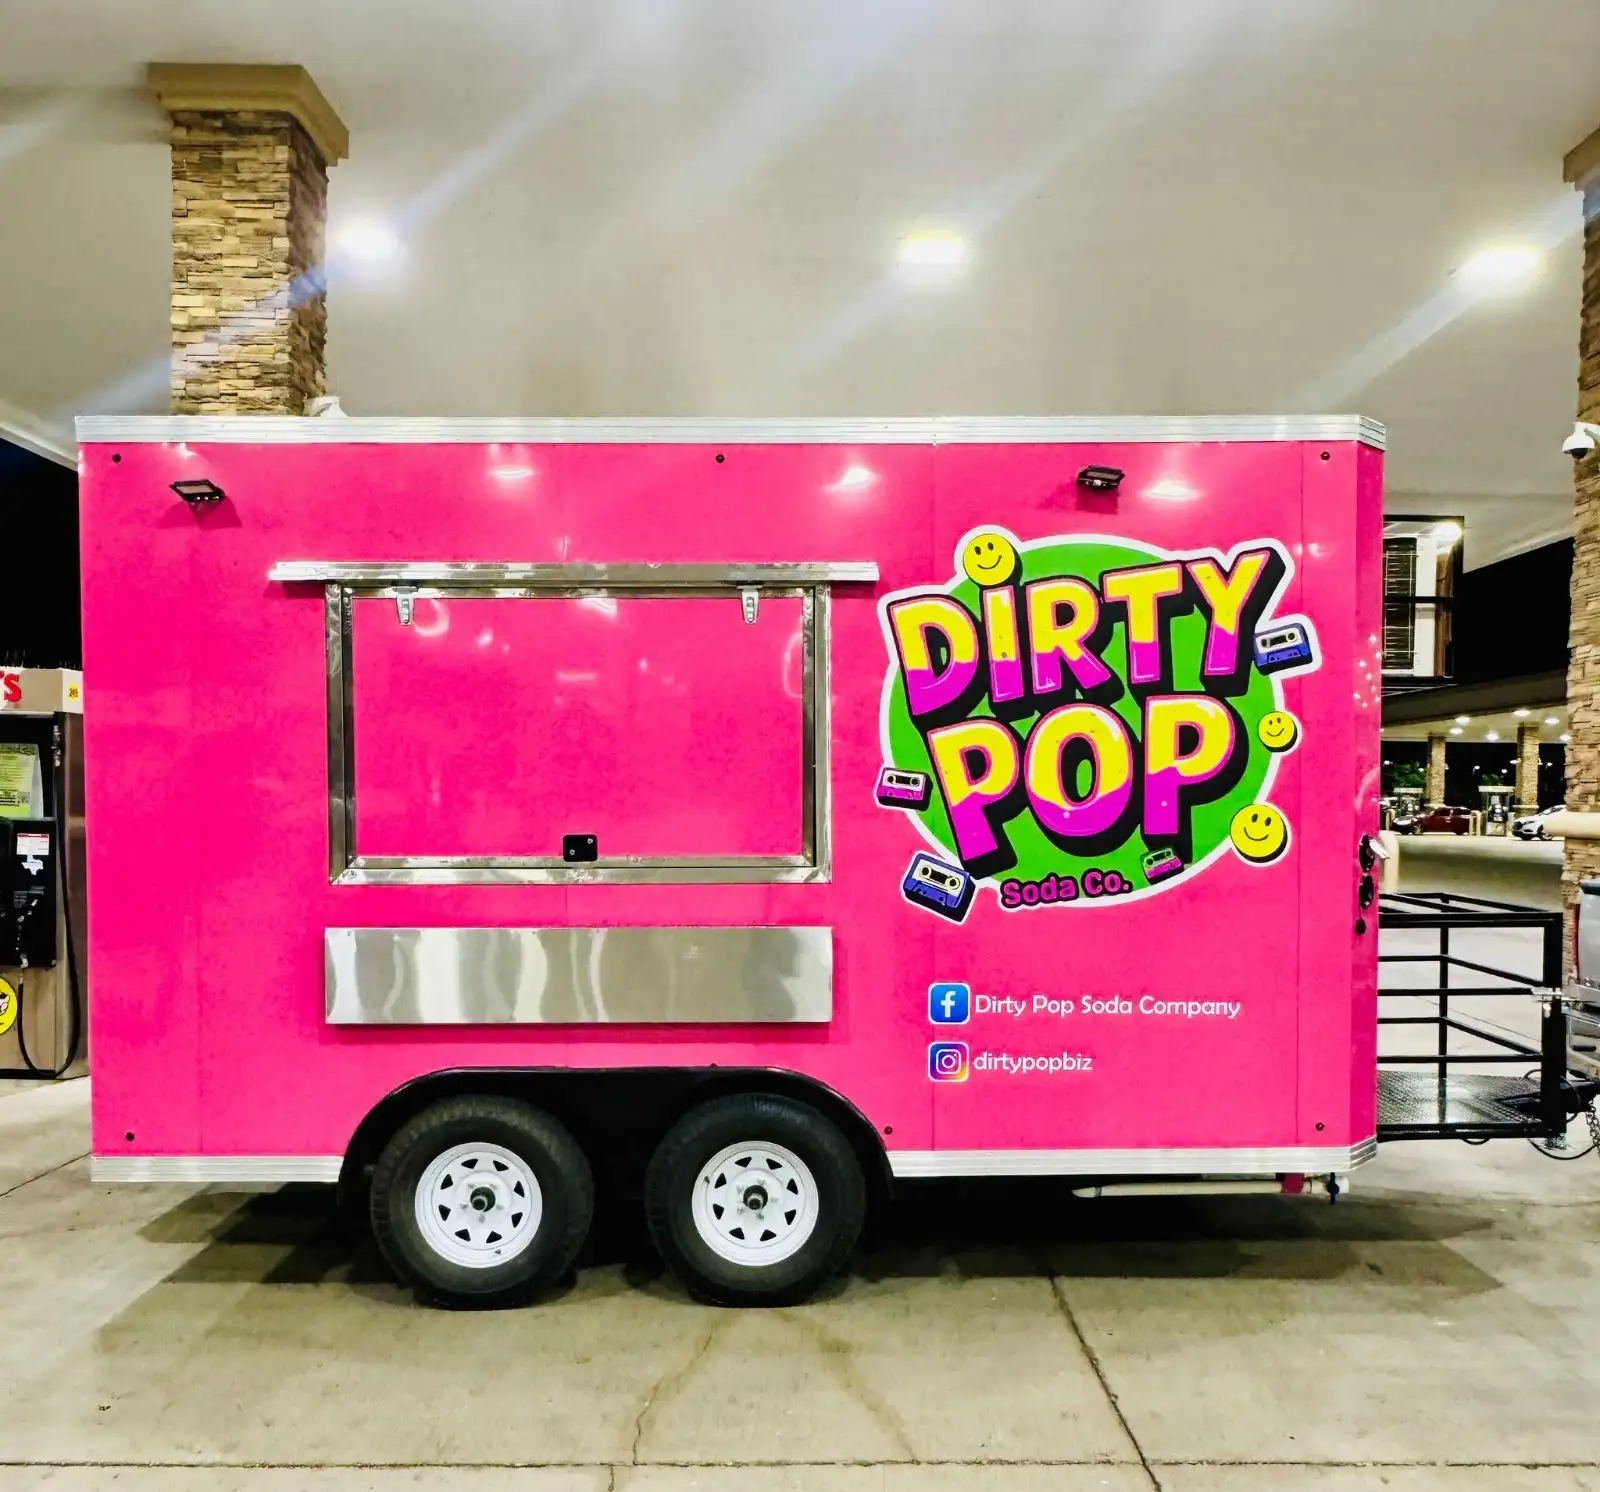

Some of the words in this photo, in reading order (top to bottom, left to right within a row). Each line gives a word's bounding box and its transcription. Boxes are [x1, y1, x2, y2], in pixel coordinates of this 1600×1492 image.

[926, 694, 1249, 879] POP
[1000, 872, 1079, 908] Soda
[1081, 868, 1133, 898] Co.
[975, 994, 1026, 1016] Dirty
[1032, 995, 1075, 1017] Pop
[1081, 995, 1132, 1015] Soda
[1138, 995, 1241, 1019] Company
[973, 1051, 1093, 1073] dirtypopbiz
